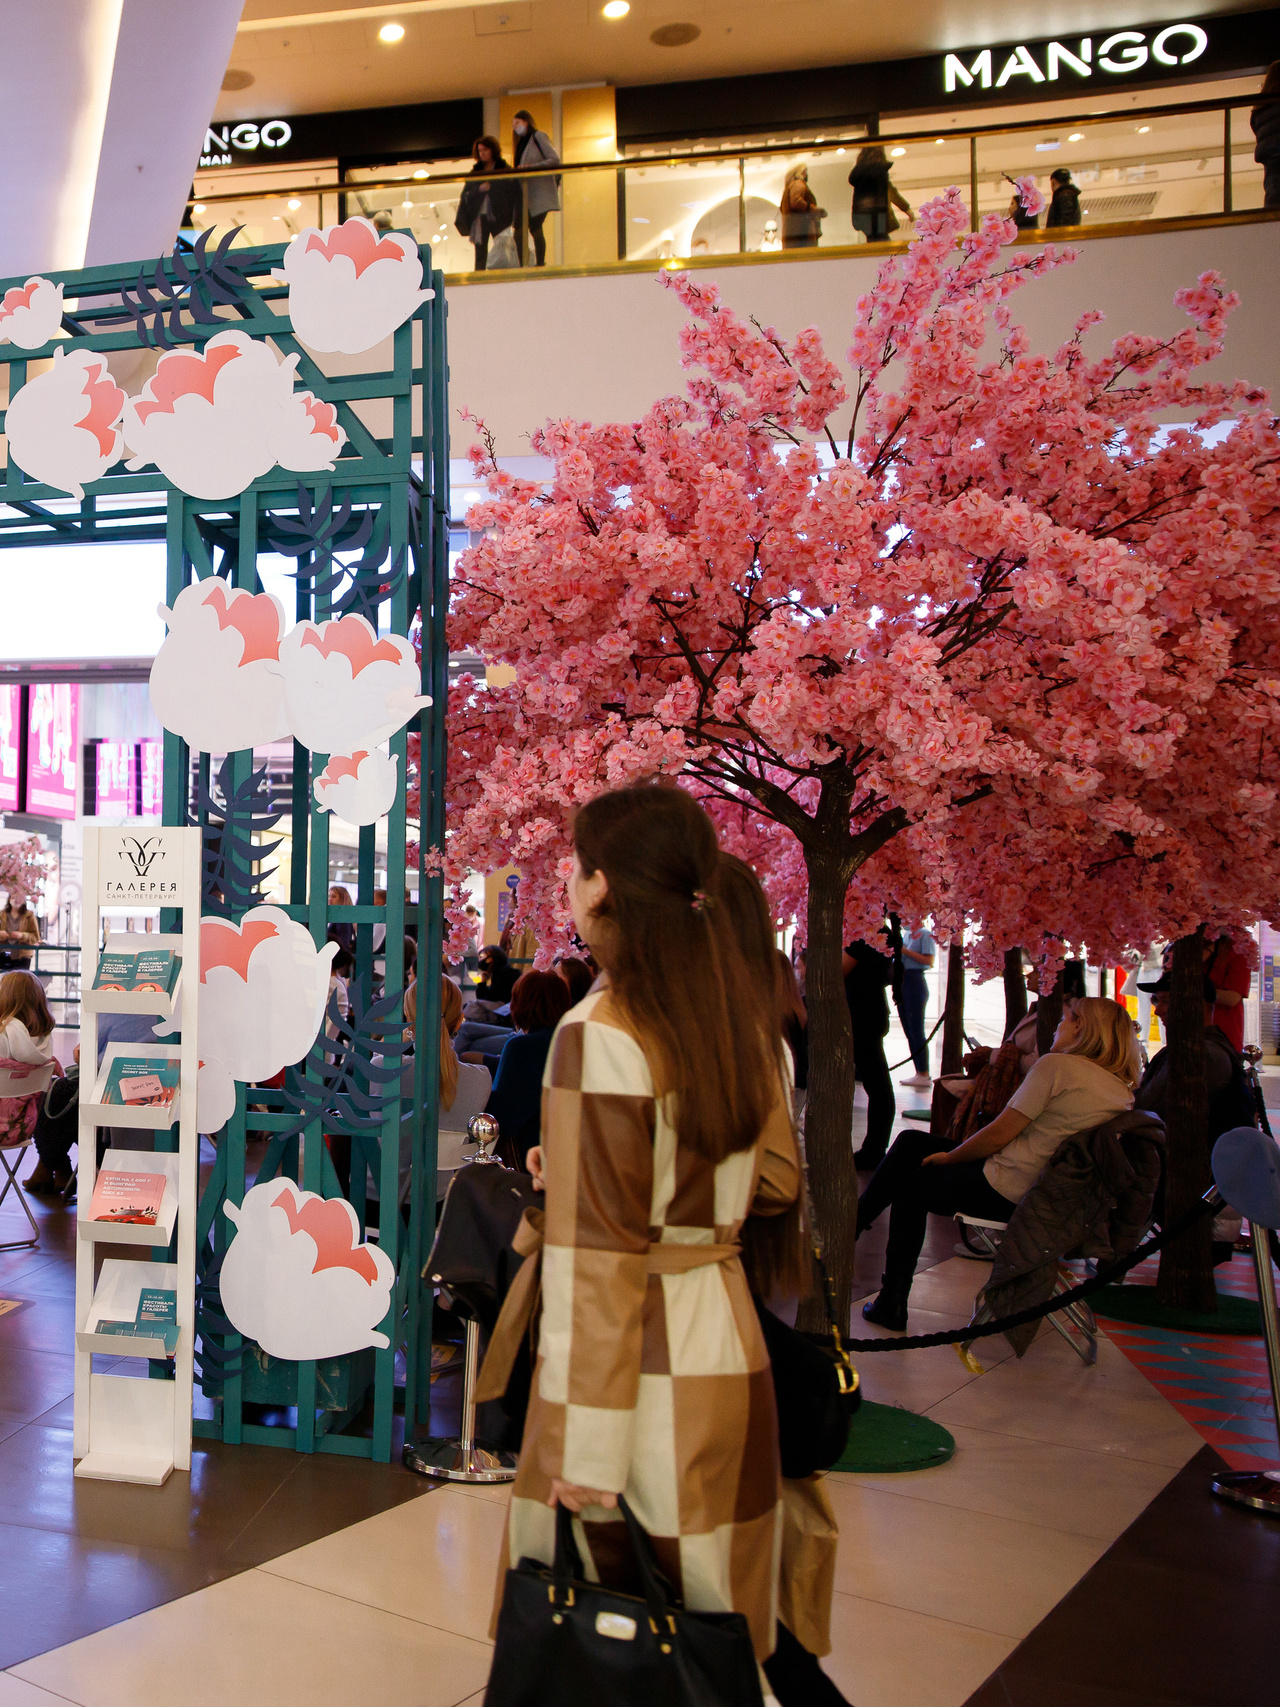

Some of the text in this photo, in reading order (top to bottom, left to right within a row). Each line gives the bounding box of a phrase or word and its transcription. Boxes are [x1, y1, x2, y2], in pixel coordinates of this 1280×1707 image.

[943, 23, 1209, 93] MANGO
[202, 120, 292, 153] NGO
[200, 153, 232, 167] MAN
[106, 882, 177, 892] ГАЛЕРЕЯ
